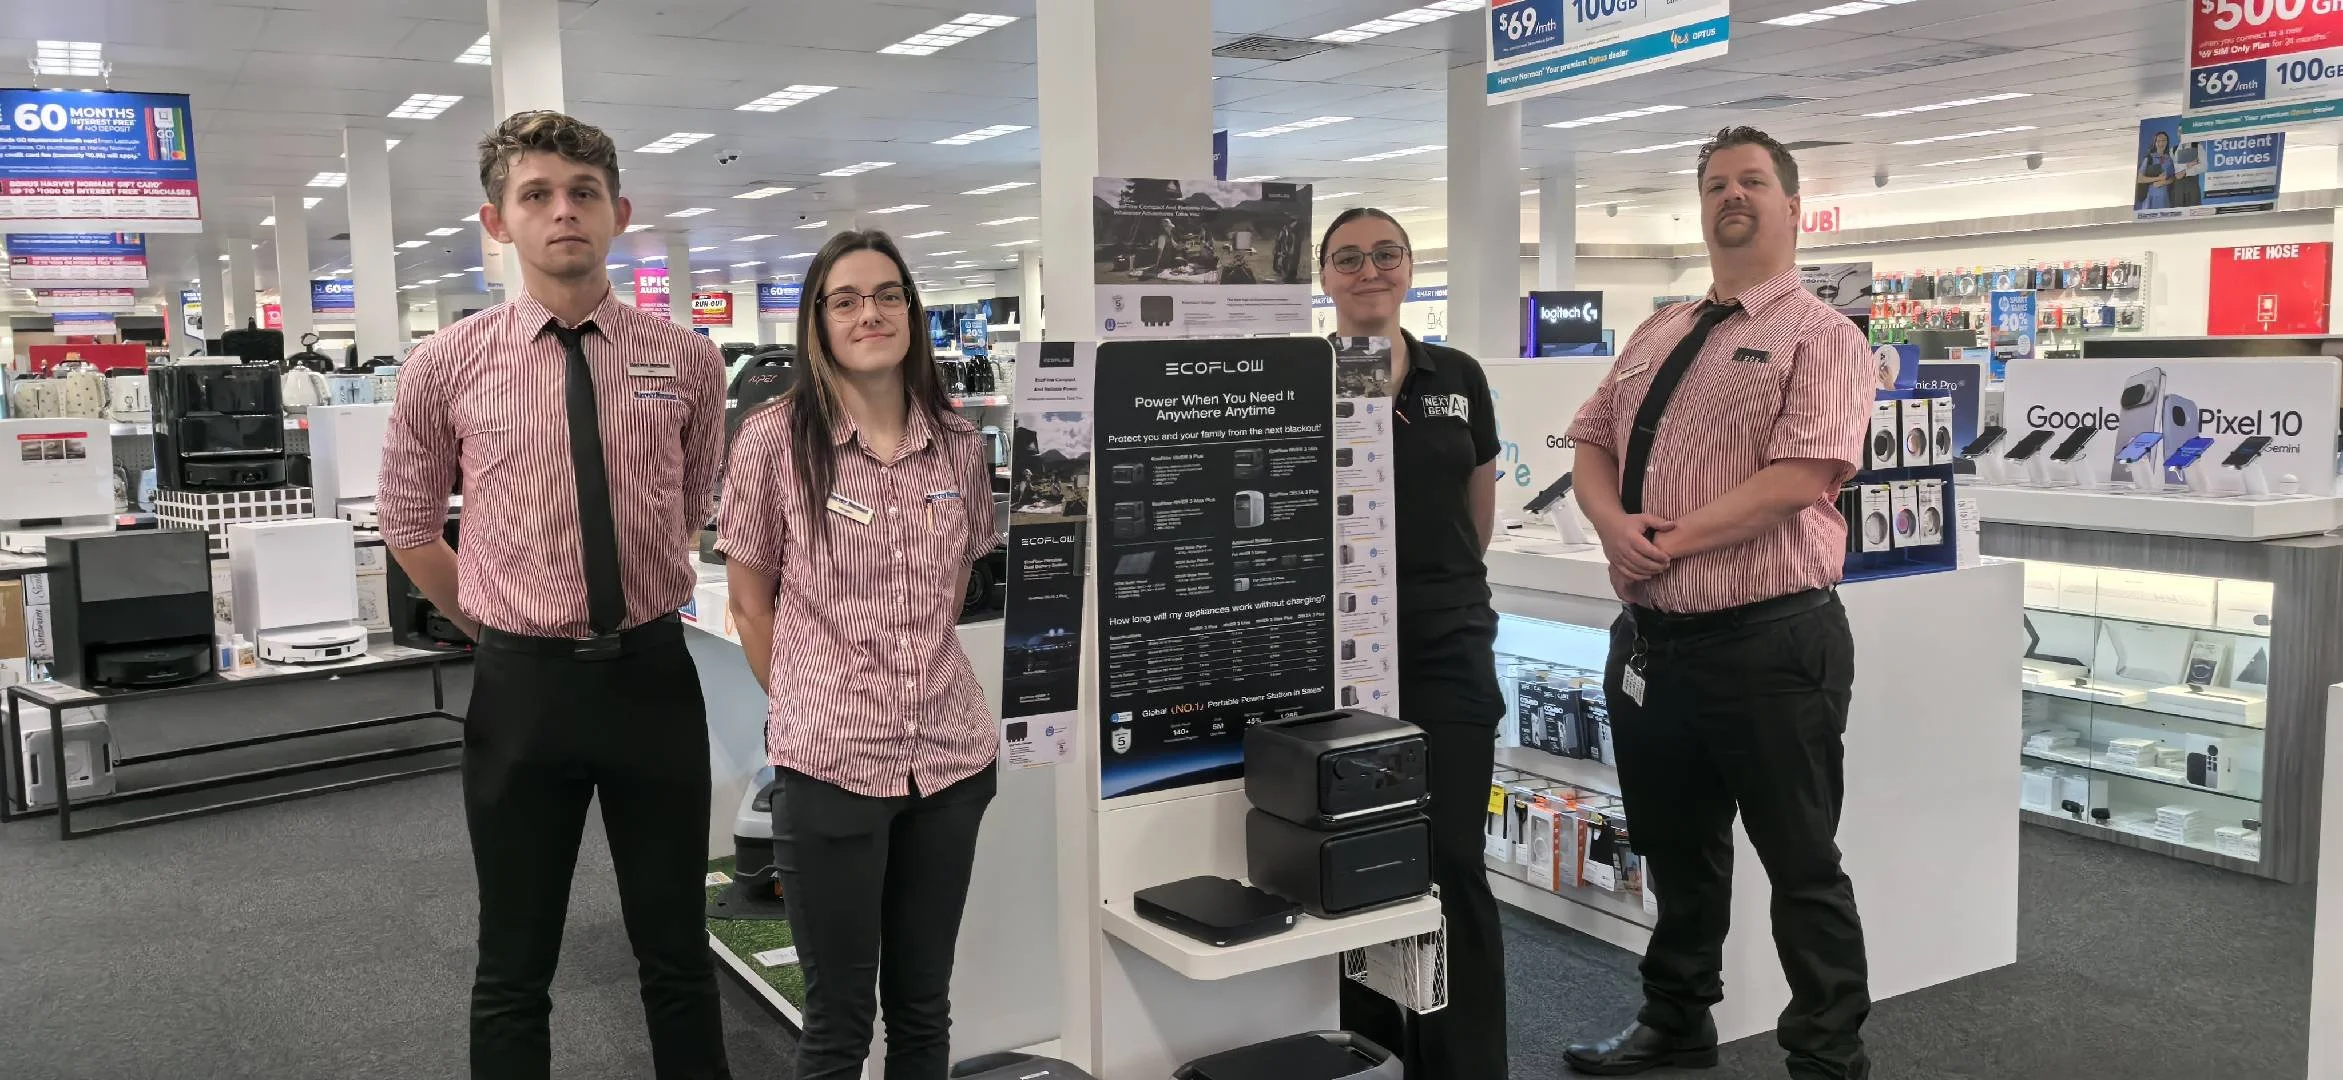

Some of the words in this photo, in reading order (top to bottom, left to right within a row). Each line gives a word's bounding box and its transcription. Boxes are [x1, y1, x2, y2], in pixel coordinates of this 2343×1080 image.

[1499, 7, 1557, 40] $69/mth
[1692, 27, 1716, 41] OPTUS
[2213, 47, 2229, 56] SIM
[2231, 44, 2250, 54] Only
[2252, 40, 2270, 50] Plan
[1498, 74, 1519, 85] Harvey
[1546, 65, 1559, 74] Your
[1560, 59, 1588, 72] premium
[1608, 49, 1629, 60] dealer
[2197, 69, 2258, 95] $69/mth
[14, 103, 68, 132] 60
[70, 107, 135, 119] MONTHS
[71, 118, 112, 127] INTEREST
[157, 129, 175, 139] GO
[2214, 135, 2272, 152] Student
[2214, 152, 2271, 168] Devices
[2233, 246, 2261, 261] FIRE
[2265, 244, 2300, 259] HOSE
[325, 283, 341, 294] 60
[639, 276, 670, 287] EPIC
[1541, 303, 1581, 323] logitech
[1165, 360, 1264, 376] ECOFLOW
[1135, 396, 1179, 408] Power
[1181, 394, 1219, 406] When
[1222, 392, 1246, 404] You
[1250, 390, 1283, 403] Need
[1287, 390, 1295, 401] It
[1156, 407, 1221, 422] Anywhere
[1225, 404, 1276, 419] Anytime
[2027, 405, 2120, 434] Google
[2198, 408, 2262, 435] Pixel
[2269, 409, 2303, 436] 10
[1108, 434, 1142, 443] Protect
[1143, 433, 1159, 443] you
[1162, 432, 1178, 440] and
[1180, 430, 1199, 441] your
[1200, 429, 1226, 439] family
[1228, 428, 1248, 437] from
[1250, 427, 1263, 436] the
[1265, 426, 1283, 435] next
[1546, 434, 1576, 449] Gala
[1021, 535, 1076, 546] ECOFLOW
[1110, 617, 1130, 626] How
[1132, 614, 1152, 624] long
[1153, 612, 1167, 621] will
[1169, 611, 1183, 620] my
[1184, 605, 1231, 619] appliances
[1231, 602, 1254, 612] work
[1254, 599, 1286, 610] without
[1286, 594, 1326, 606] charging?
[1141, 708, 1168, 718] Global
[1207, 698, 1240, 709] Portable
[1241, 696, 1265, 704] Power
[1266, 691, 1292, 701] Station
